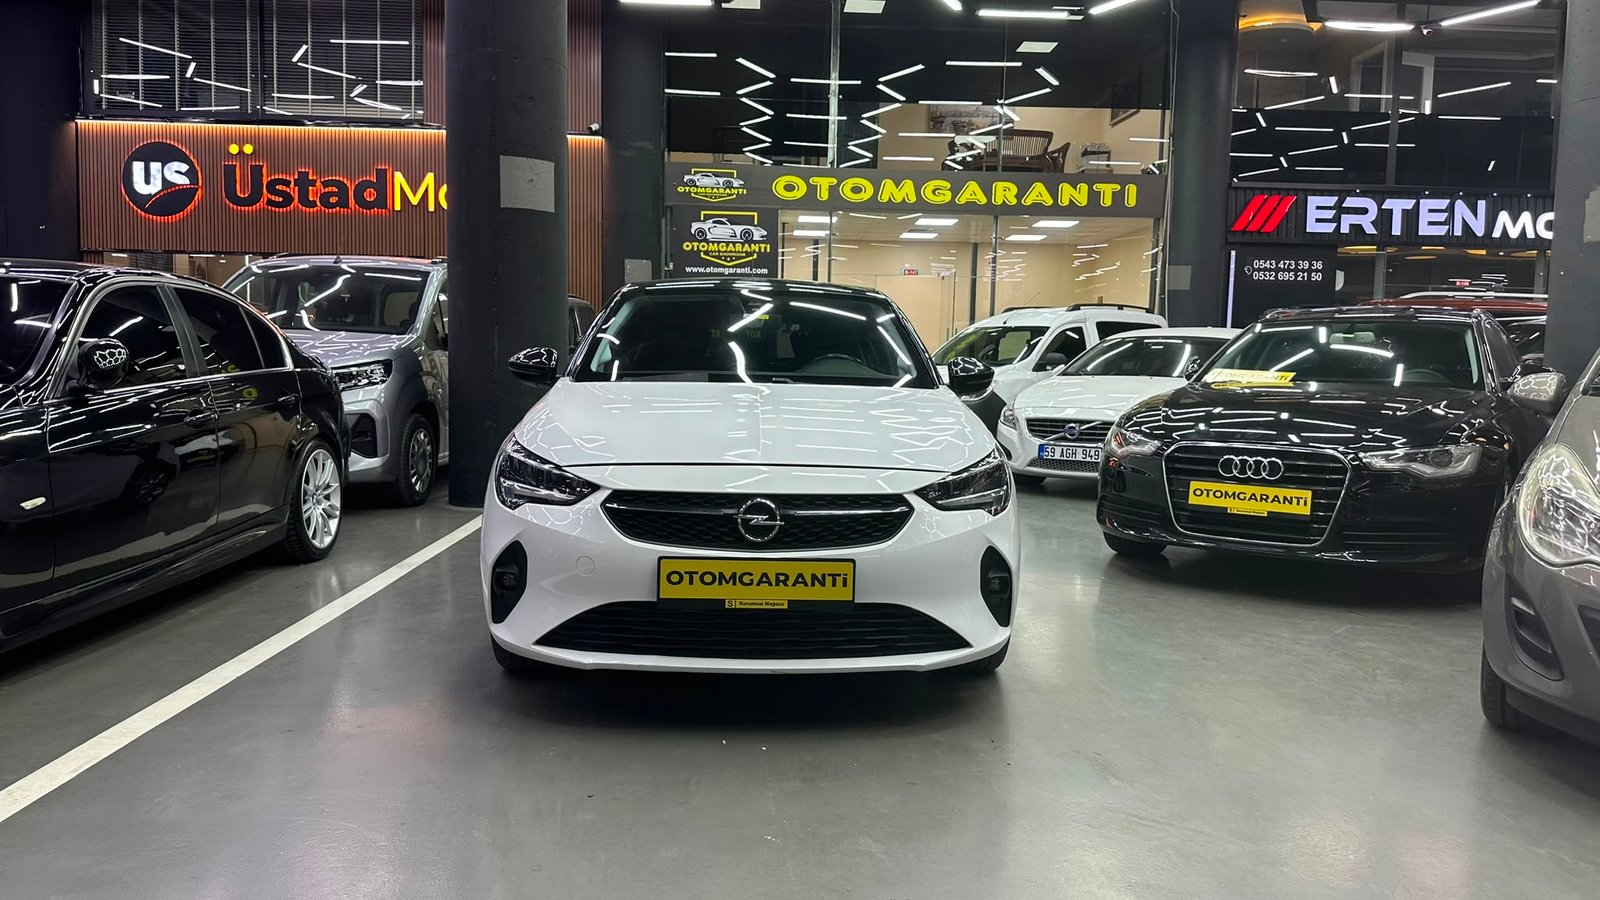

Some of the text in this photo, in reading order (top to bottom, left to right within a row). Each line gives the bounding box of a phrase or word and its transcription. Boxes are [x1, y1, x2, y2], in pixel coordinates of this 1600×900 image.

[677, 186, 747, 195] OTOMGARANTI
[771, 174, 1138, 208] OTOMGARANTI
[1306, 195, 1486, 237] ERTEN
[682, 241, 770, 253] OTOMGARANTI
[685, 266, 768, 275] www.otomgaranti.com
[1253, 260, 1323, 270] 0543 473 39 36
[1252, 271, 1322, 281] 0532 695 21 50
[1044, 447, 1100, 460] 59 AGH 949
